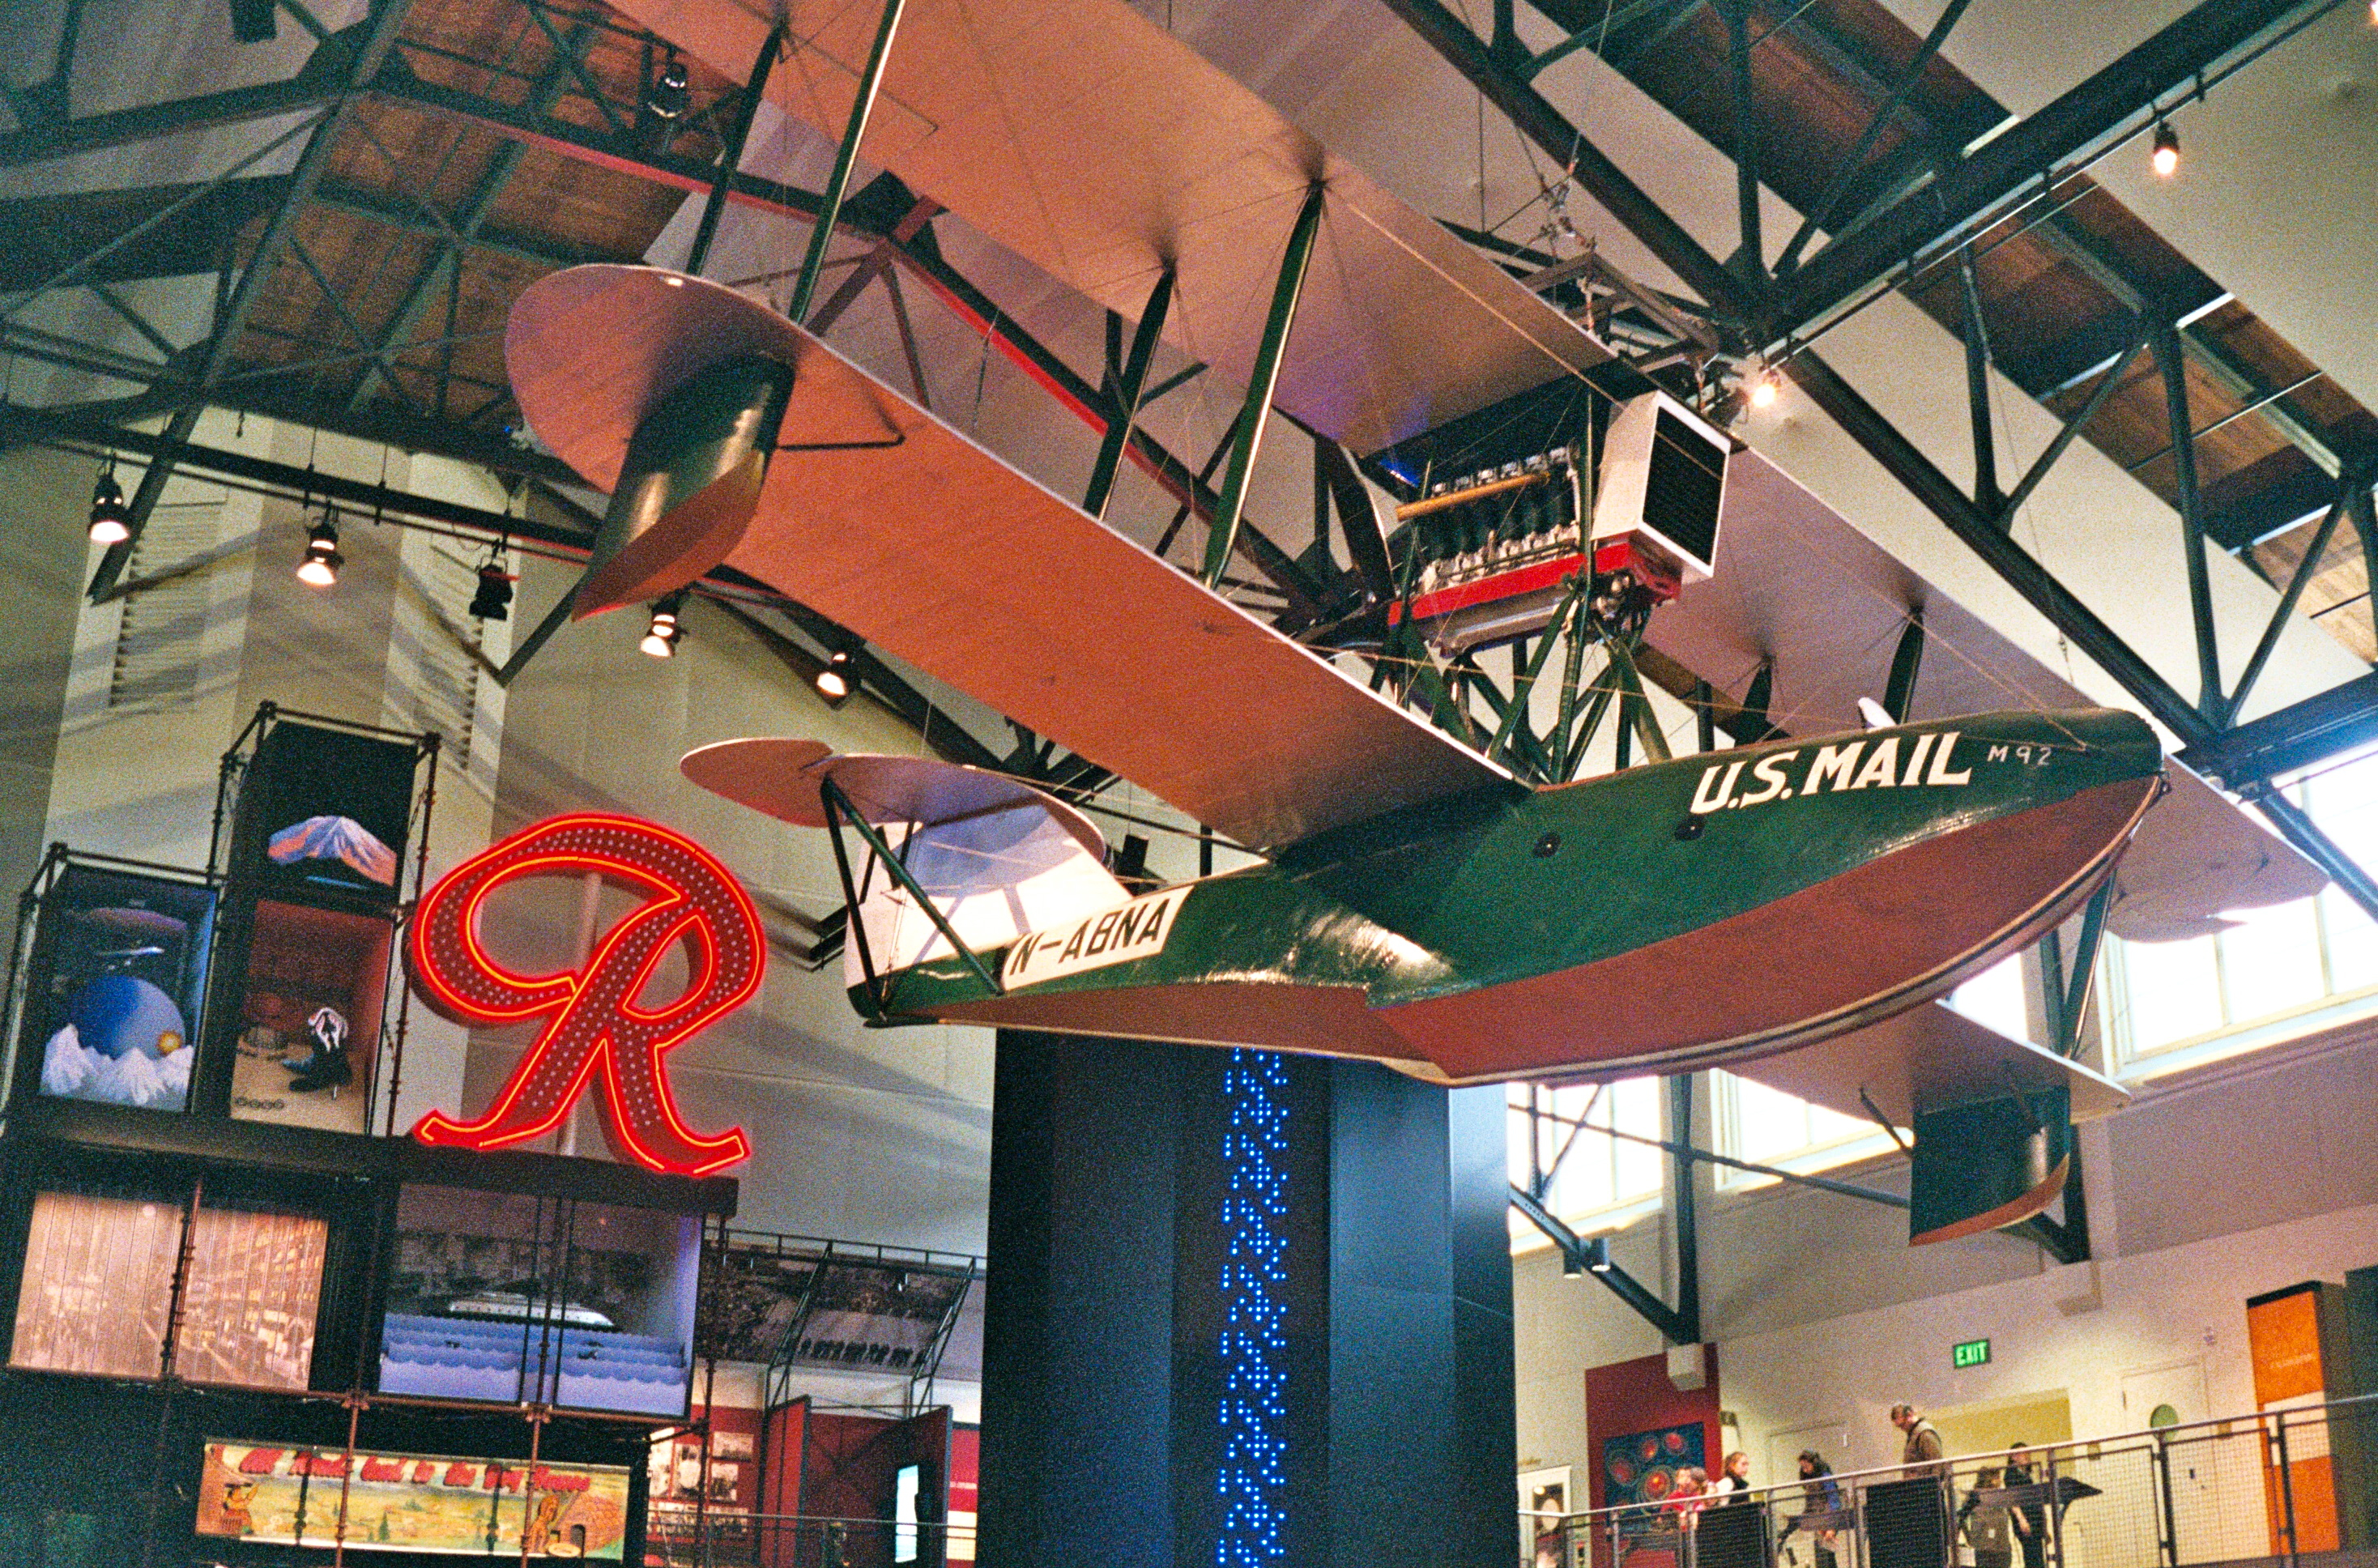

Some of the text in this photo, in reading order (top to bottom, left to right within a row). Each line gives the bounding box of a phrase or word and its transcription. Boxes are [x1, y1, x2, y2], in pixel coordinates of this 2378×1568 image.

[1009, 897, 1171, 976] N-ABNA
[411, 812, 766, 1178] R
[1956, 1342, 1986, 1366] EXIT
